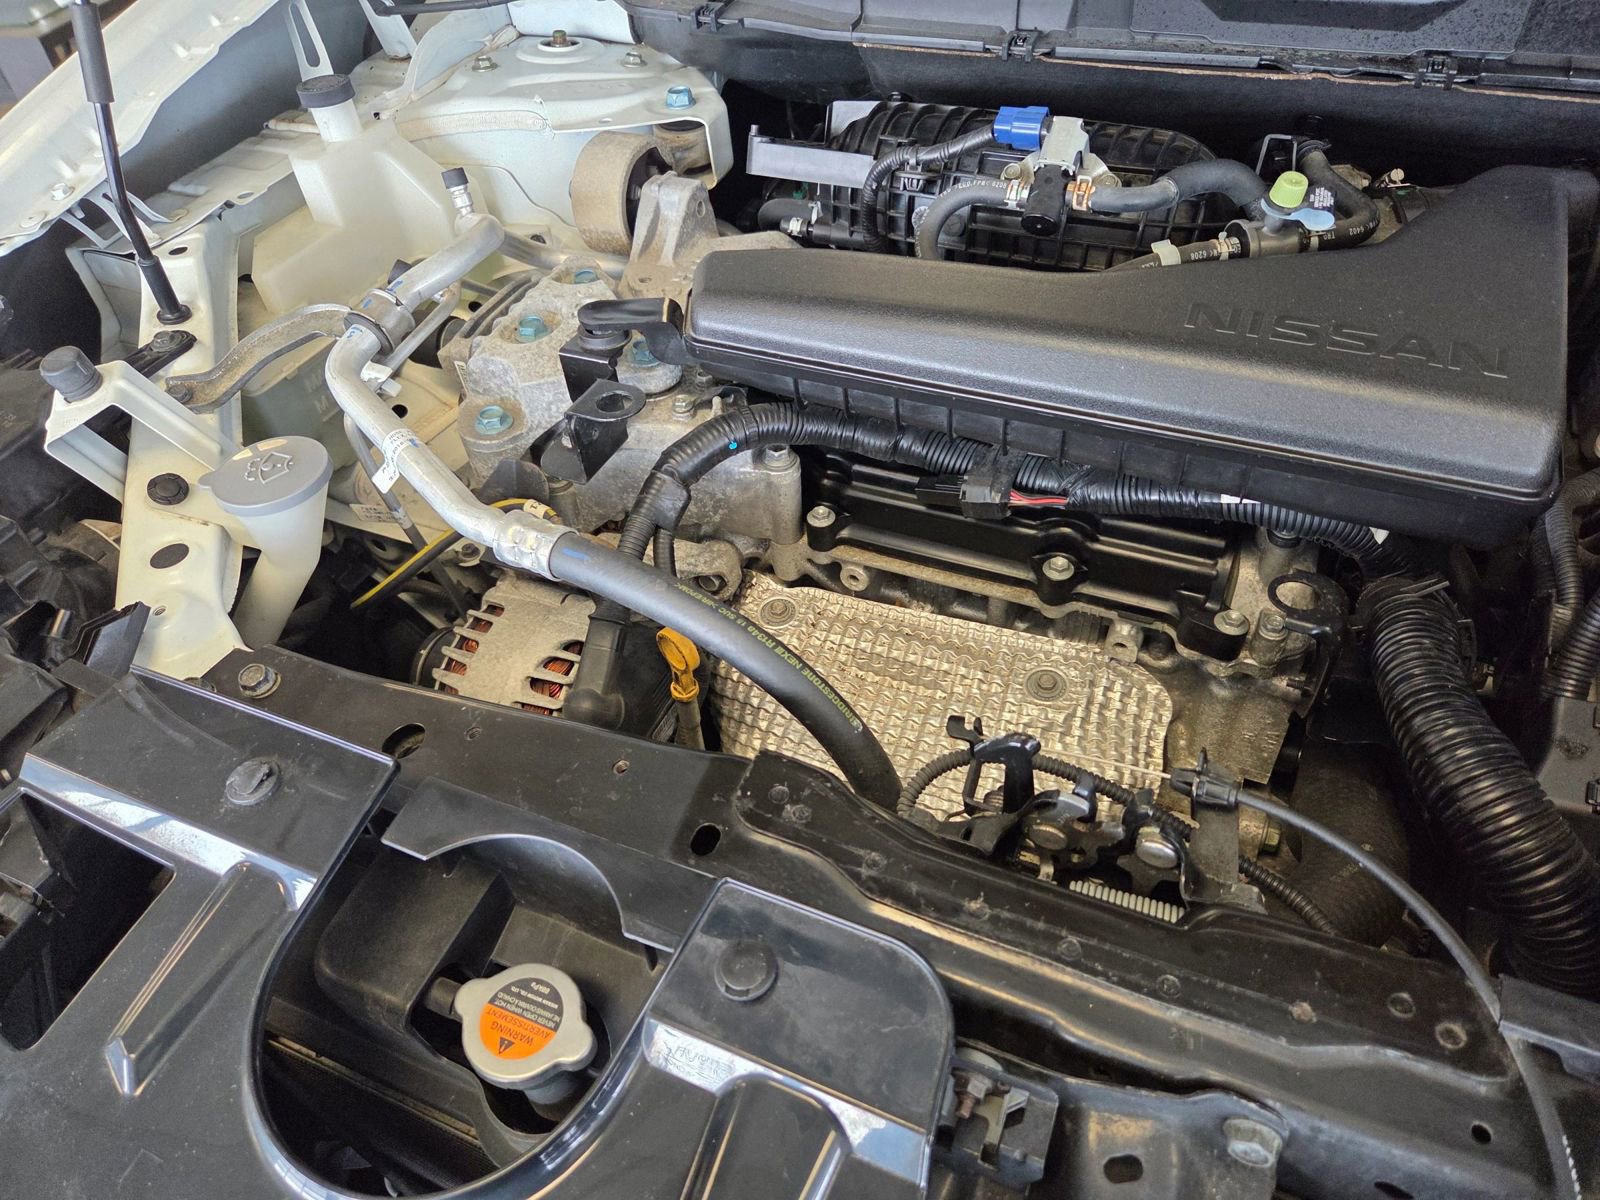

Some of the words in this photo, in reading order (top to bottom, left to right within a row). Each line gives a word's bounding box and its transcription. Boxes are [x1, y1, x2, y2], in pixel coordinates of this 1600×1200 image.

[1184, 303, 1508, 378] NISSAN
[506, 1003, 523, 1013] WHEN
[522, 1009, 538, 1020] OPEN
[487, 1007, 550, 1039] AVERTISSEMENT
[537, 1016, 556, 1028] NEVER
[490, 1021, 534, 1046] WARNING
